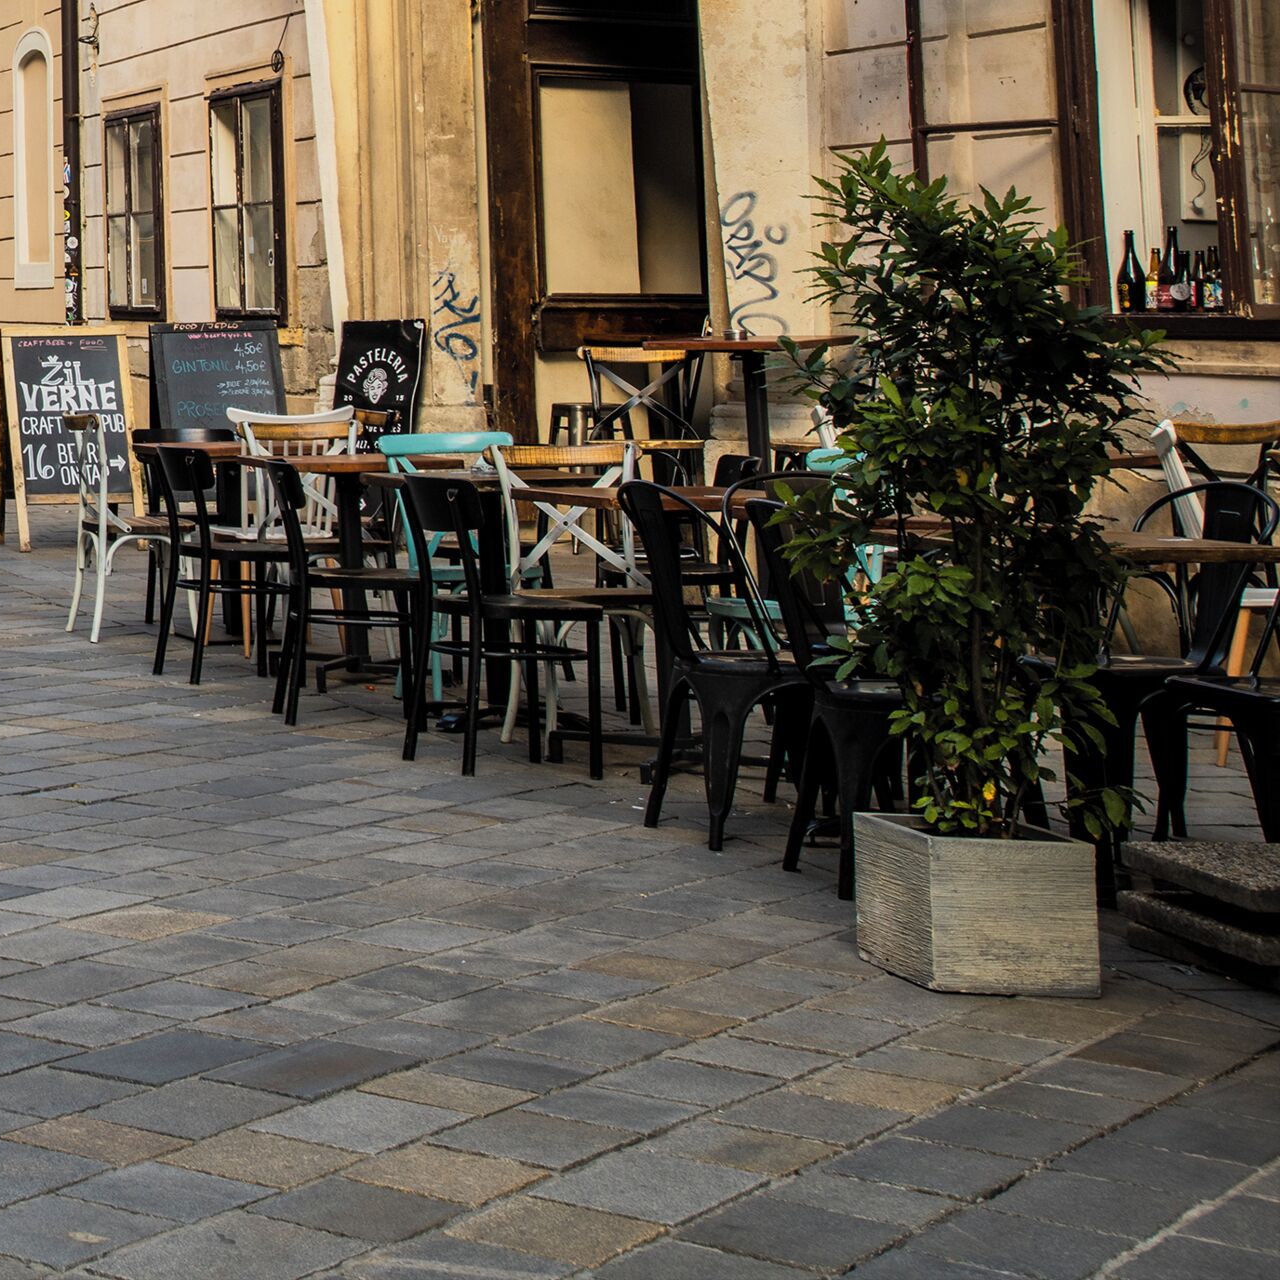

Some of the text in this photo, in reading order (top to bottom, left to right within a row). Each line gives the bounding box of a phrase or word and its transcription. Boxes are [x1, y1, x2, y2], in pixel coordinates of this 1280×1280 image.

[18, 340, 43, 348] CRAFT
[346, 348, 408, 383] PASTELERIA
[19, 380, 118, 412] VERNE
[21, 413, 126, 435] CRAFT PUB
[23, 443, 55, 481] 16
